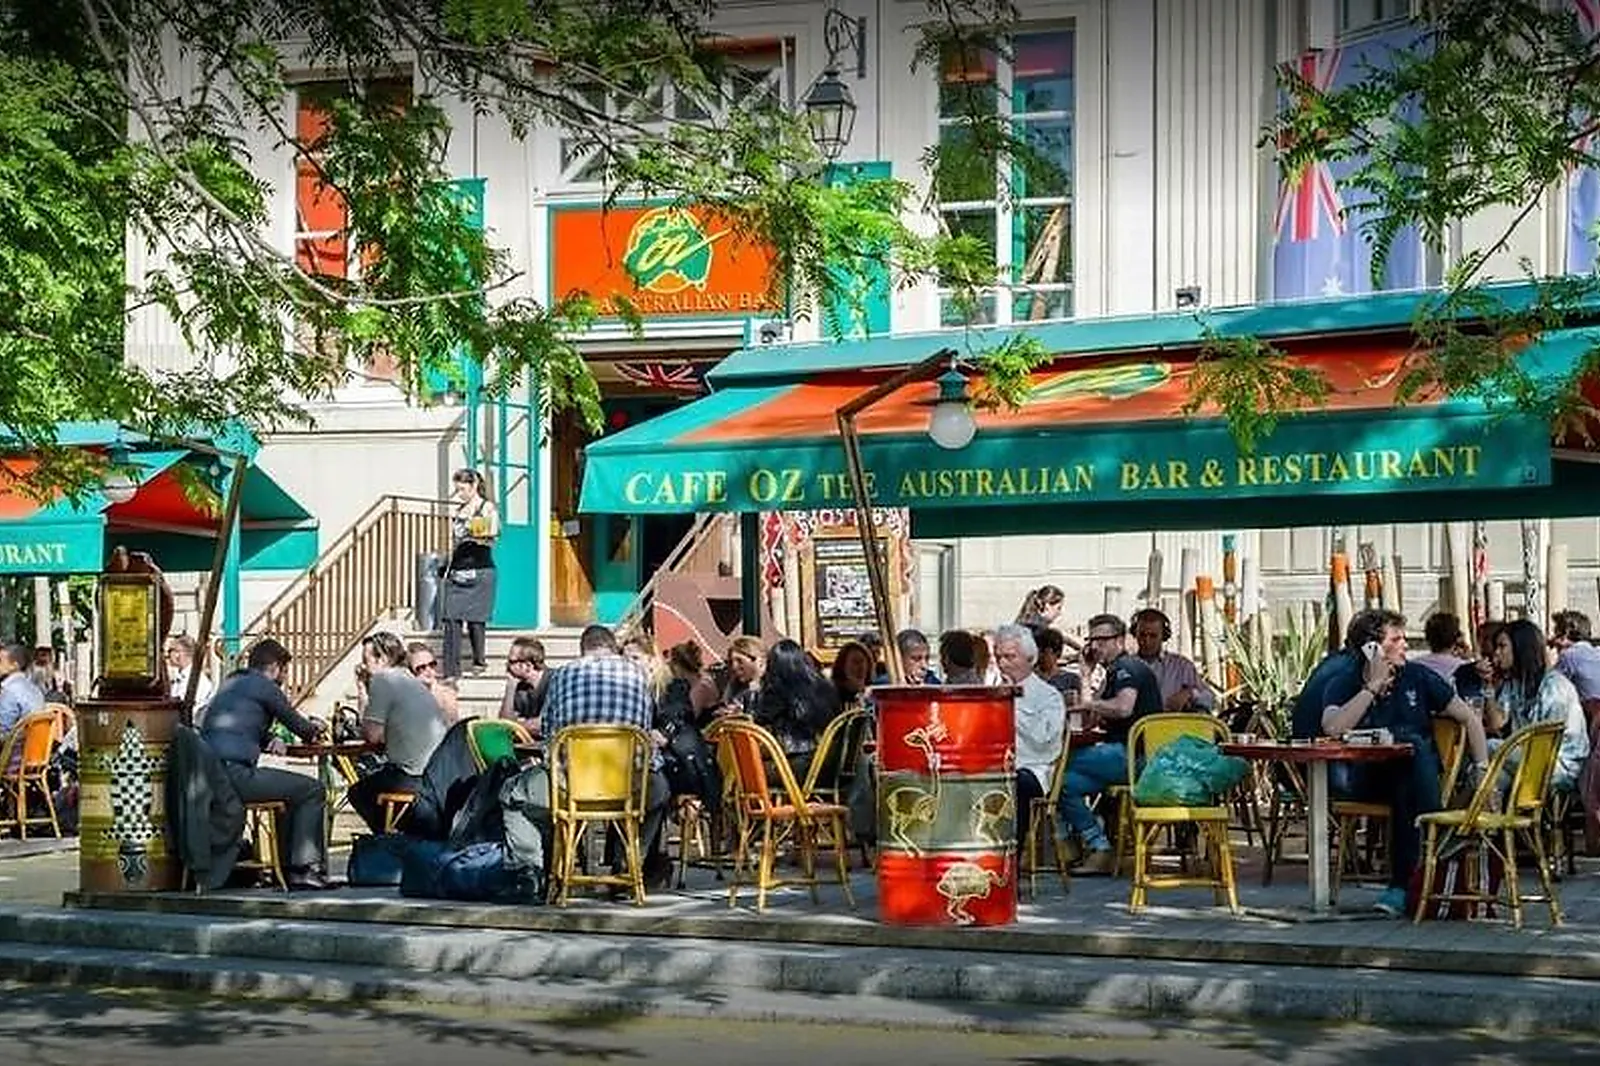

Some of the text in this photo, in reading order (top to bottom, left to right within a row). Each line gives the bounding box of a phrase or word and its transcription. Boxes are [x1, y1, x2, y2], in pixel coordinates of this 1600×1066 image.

[624, 445, 1482, 505] CAFE OZ THE AUSTRALIAN BAR & RESTAURANT
